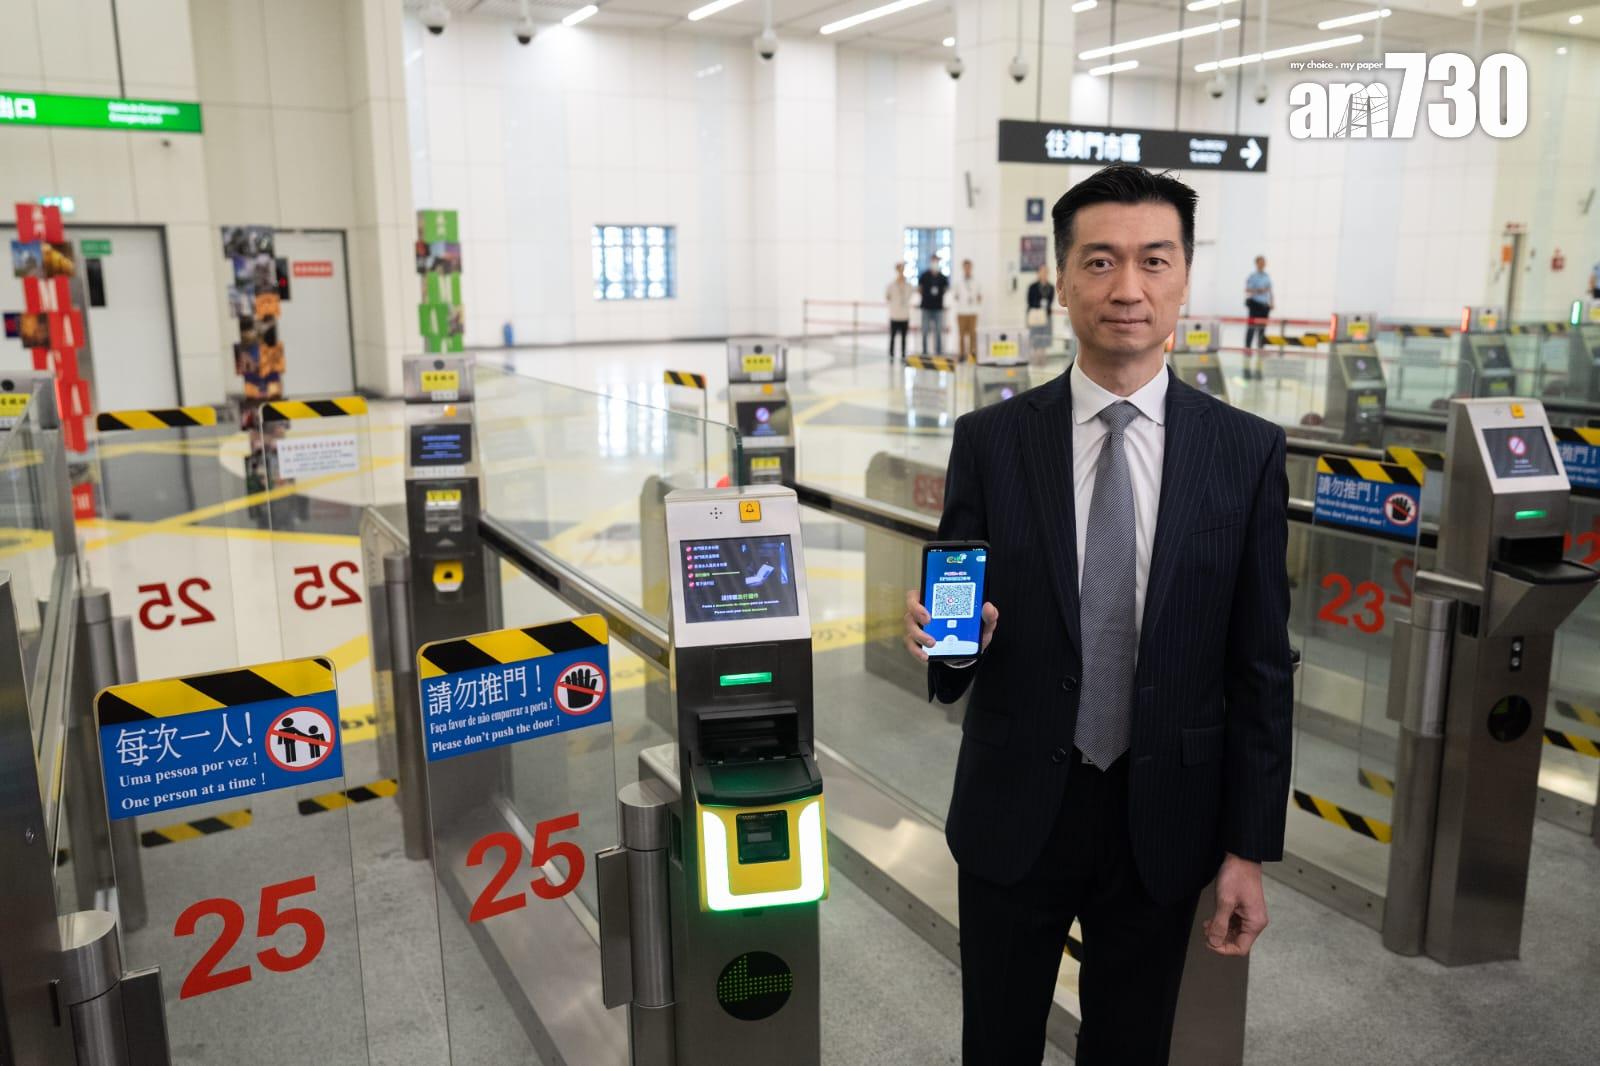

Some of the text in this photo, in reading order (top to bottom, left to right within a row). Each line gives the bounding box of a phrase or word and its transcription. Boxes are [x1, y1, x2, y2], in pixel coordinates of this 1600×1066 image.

[1318, 572, 1385, 633] 23
[427, 664, 542, 717] 請勿推門！
[430, 721, 448, 735] Faça
[448, 717, 467, 730] favor
[467, 715, 477, 726] de
[477, 711, 491, 724] não
[491, 706, 524, 724] empurrar
[524, 706, 529, 715] a
[530, 700, 548, 717] porta
[432, 740, 462, 753] Please
[464, 732, 490, 746] don't
[492, 725, 514, 742] push
[516, 722, 531, 734] the
[533, 717, 554, 731] door
[119, 775, 151, 789] Uma
[155, 765, 198, 784] pessoa
[202, 759, 225, 776] por
[227, 757, 248, 769] vez
[121, 797, 150, 811] One
[153, 788, 198, 808] person
[201, 784, 214, 795] at
[218, 783, 225, 792] a
[228, 776, 257, 790] time
[465, 812, 586, 924] 25
[174, 875, 326, 1000] 25
